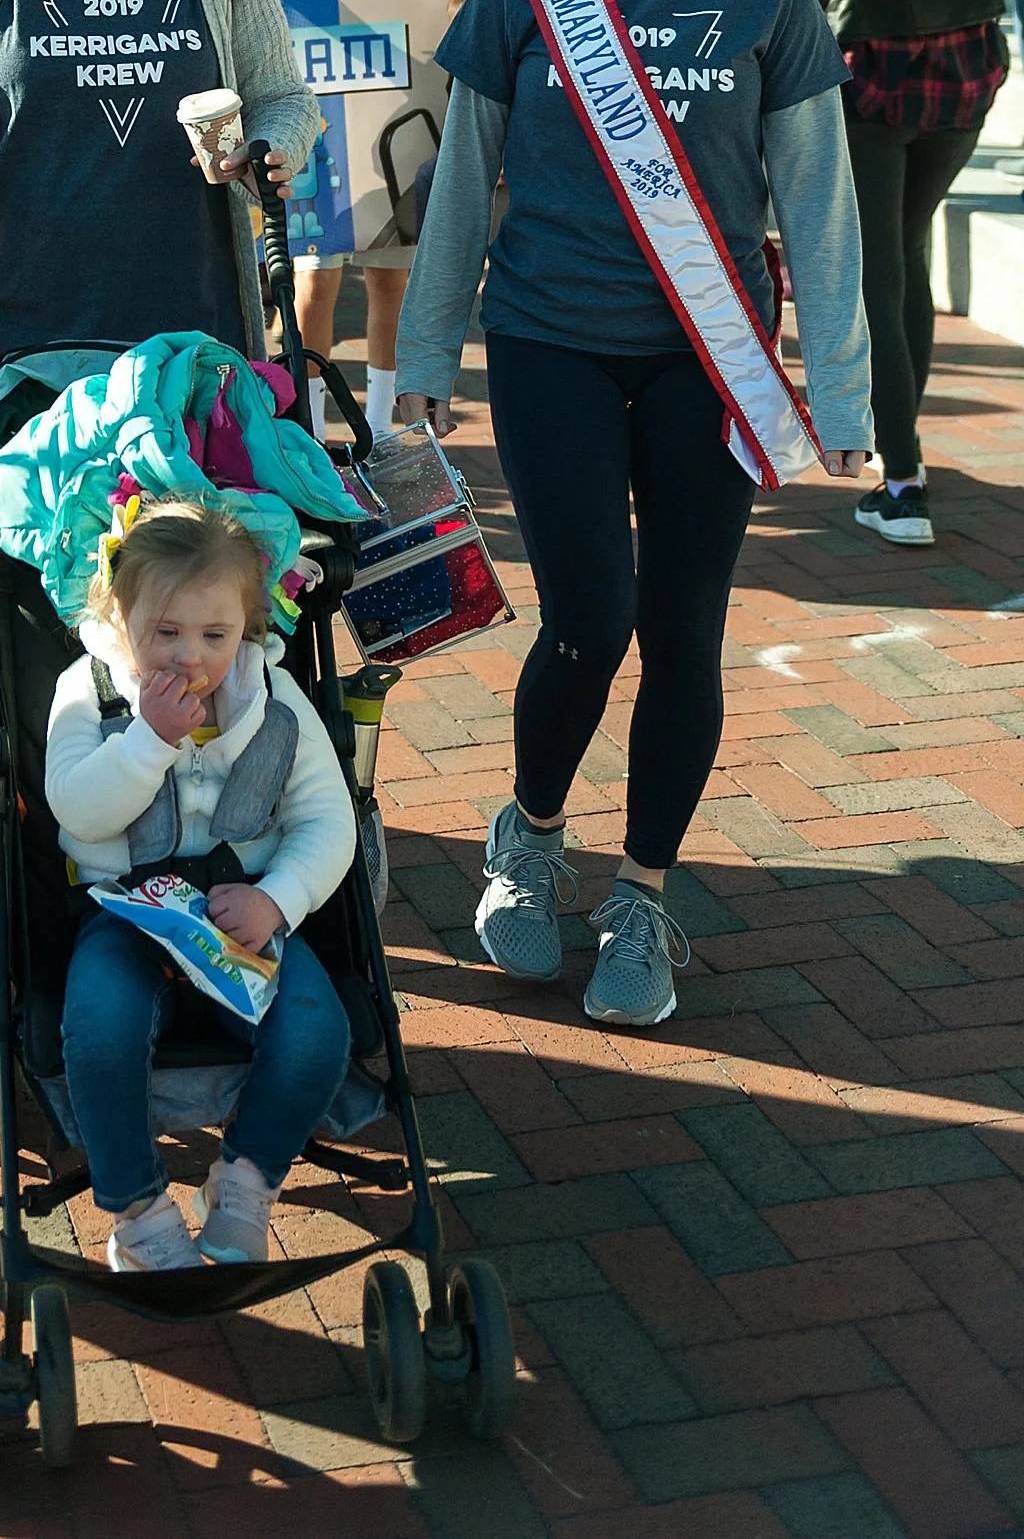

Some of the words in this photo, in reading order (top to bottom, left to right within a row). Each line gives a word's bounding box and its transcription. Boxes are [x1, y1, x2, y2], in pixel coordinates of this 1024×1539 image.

[29, 29, 202, 57] KERRIGAN'S
[627, 25, 677, 48] 019
[294, 33, 396, 83] AM
[76, 60, 164, 87] KREW
[620, 158, 682, 199] AMERICA
[647, 158, 673, 182] FOR
[630, 178, 659, 199] 2019
